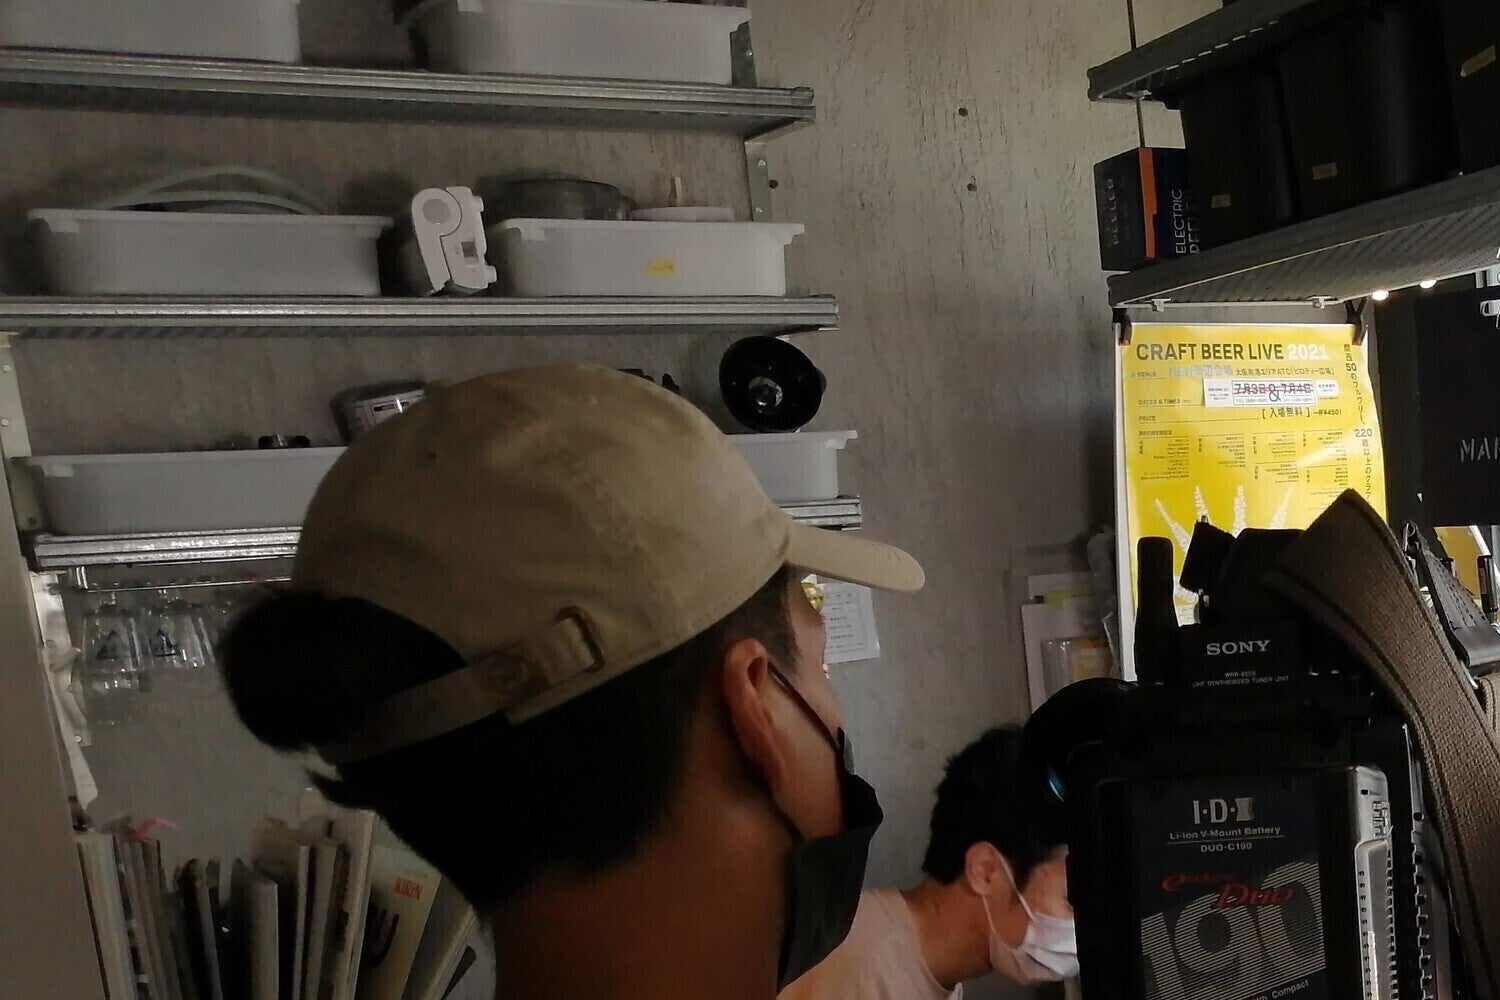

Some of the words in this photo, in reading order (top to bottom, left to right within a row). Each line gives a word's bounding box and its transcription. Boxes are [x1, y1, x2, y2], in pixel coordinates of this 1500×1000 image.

[1171, 188, 1187, 254] ELECTRIC
[1136, 343, 1197, 361] CRAFT
[1201, 343, 1244, 360] BEER
[1249, 343, 1284, 360] LIVE
[1287, 343, 1329, 360] 2021
[1206, 639, 1272, 656] SONY
[1244, 826, 1281, 836] Battery
[1271, 979, 1310, 1000] Compact
